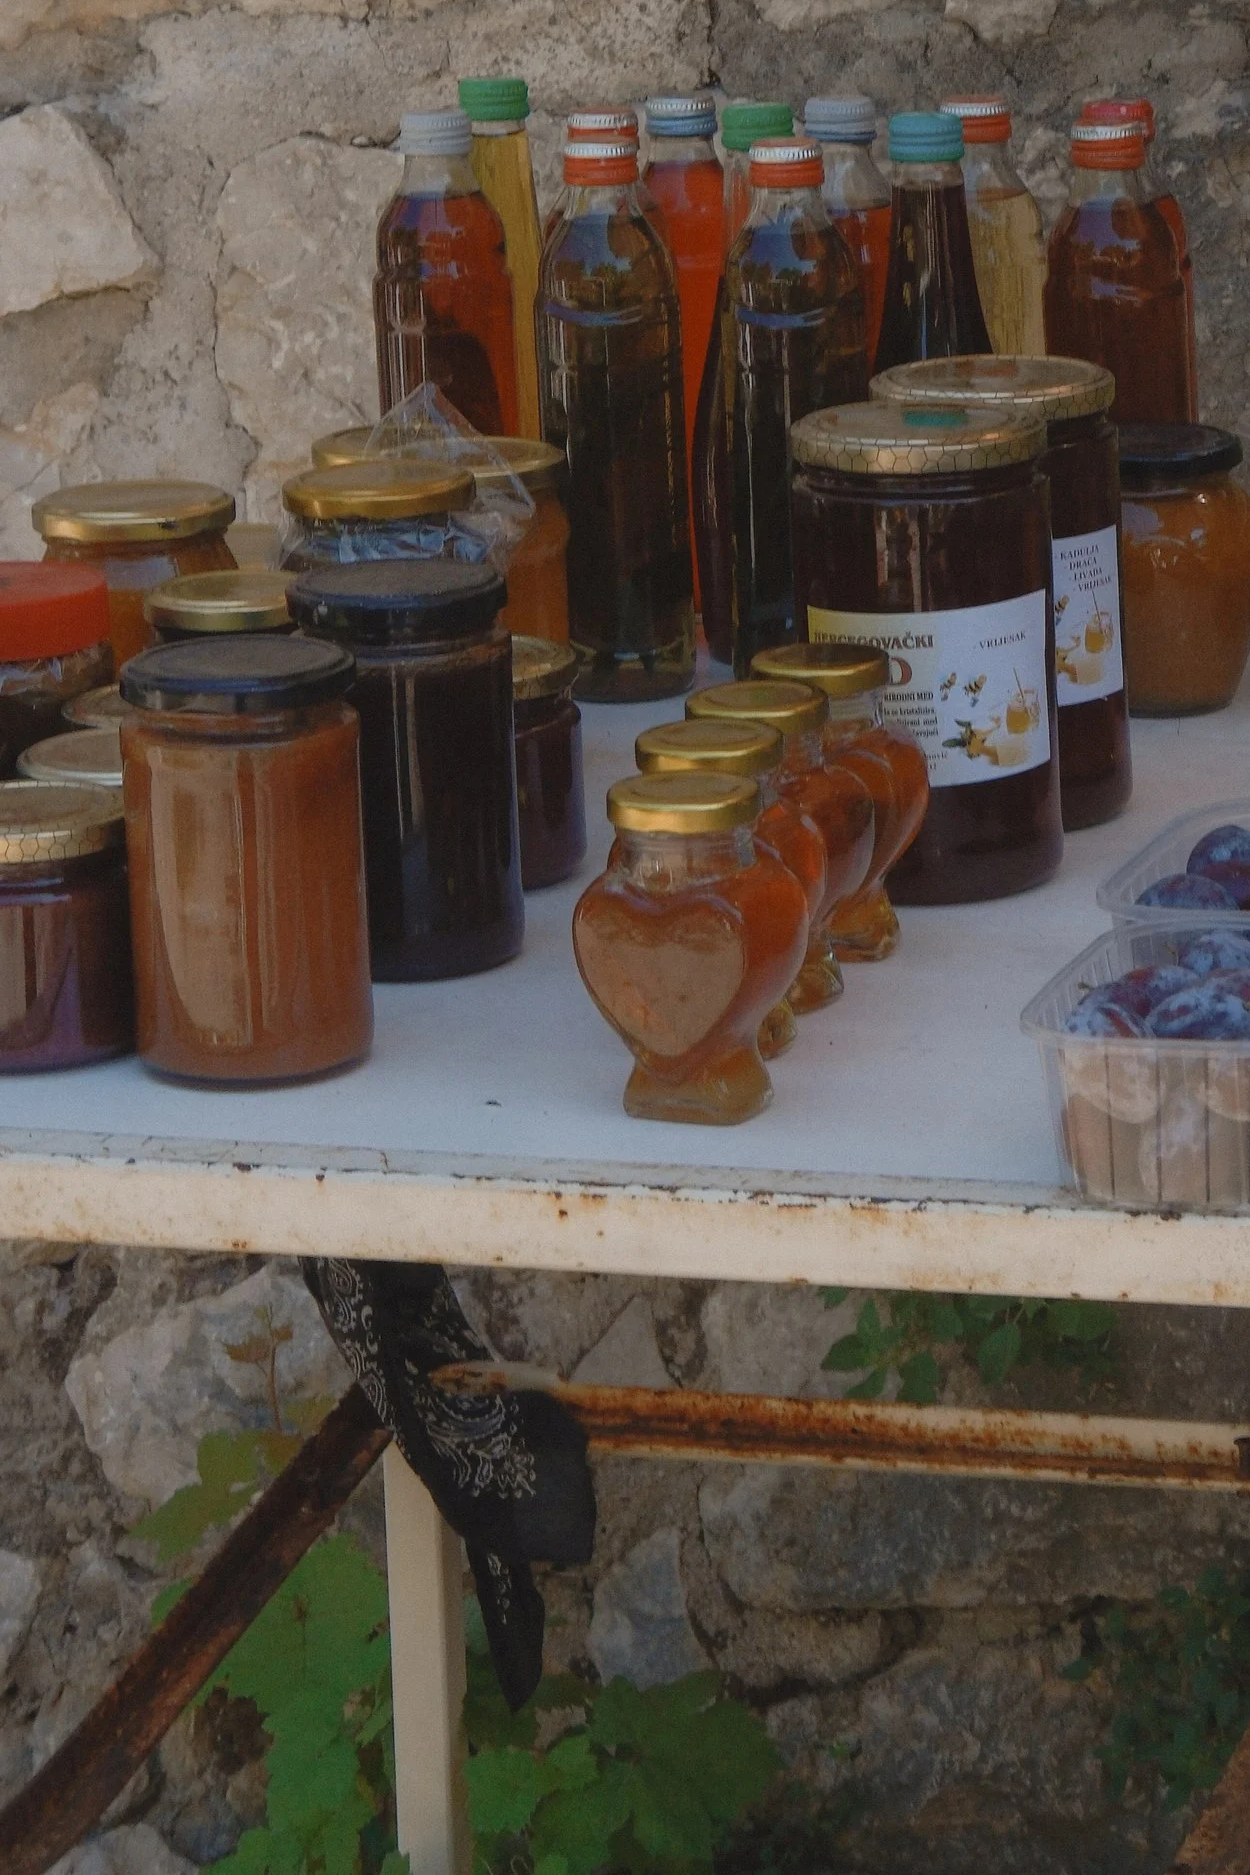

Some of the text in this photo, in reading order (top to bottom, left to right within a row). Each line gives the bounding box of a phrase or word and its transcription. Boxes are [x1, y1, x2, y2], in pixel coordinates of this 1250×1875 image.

[1060, 544, 1099, 561] KADULJA
[883, 691, 934, 702] RIRODNI MED
